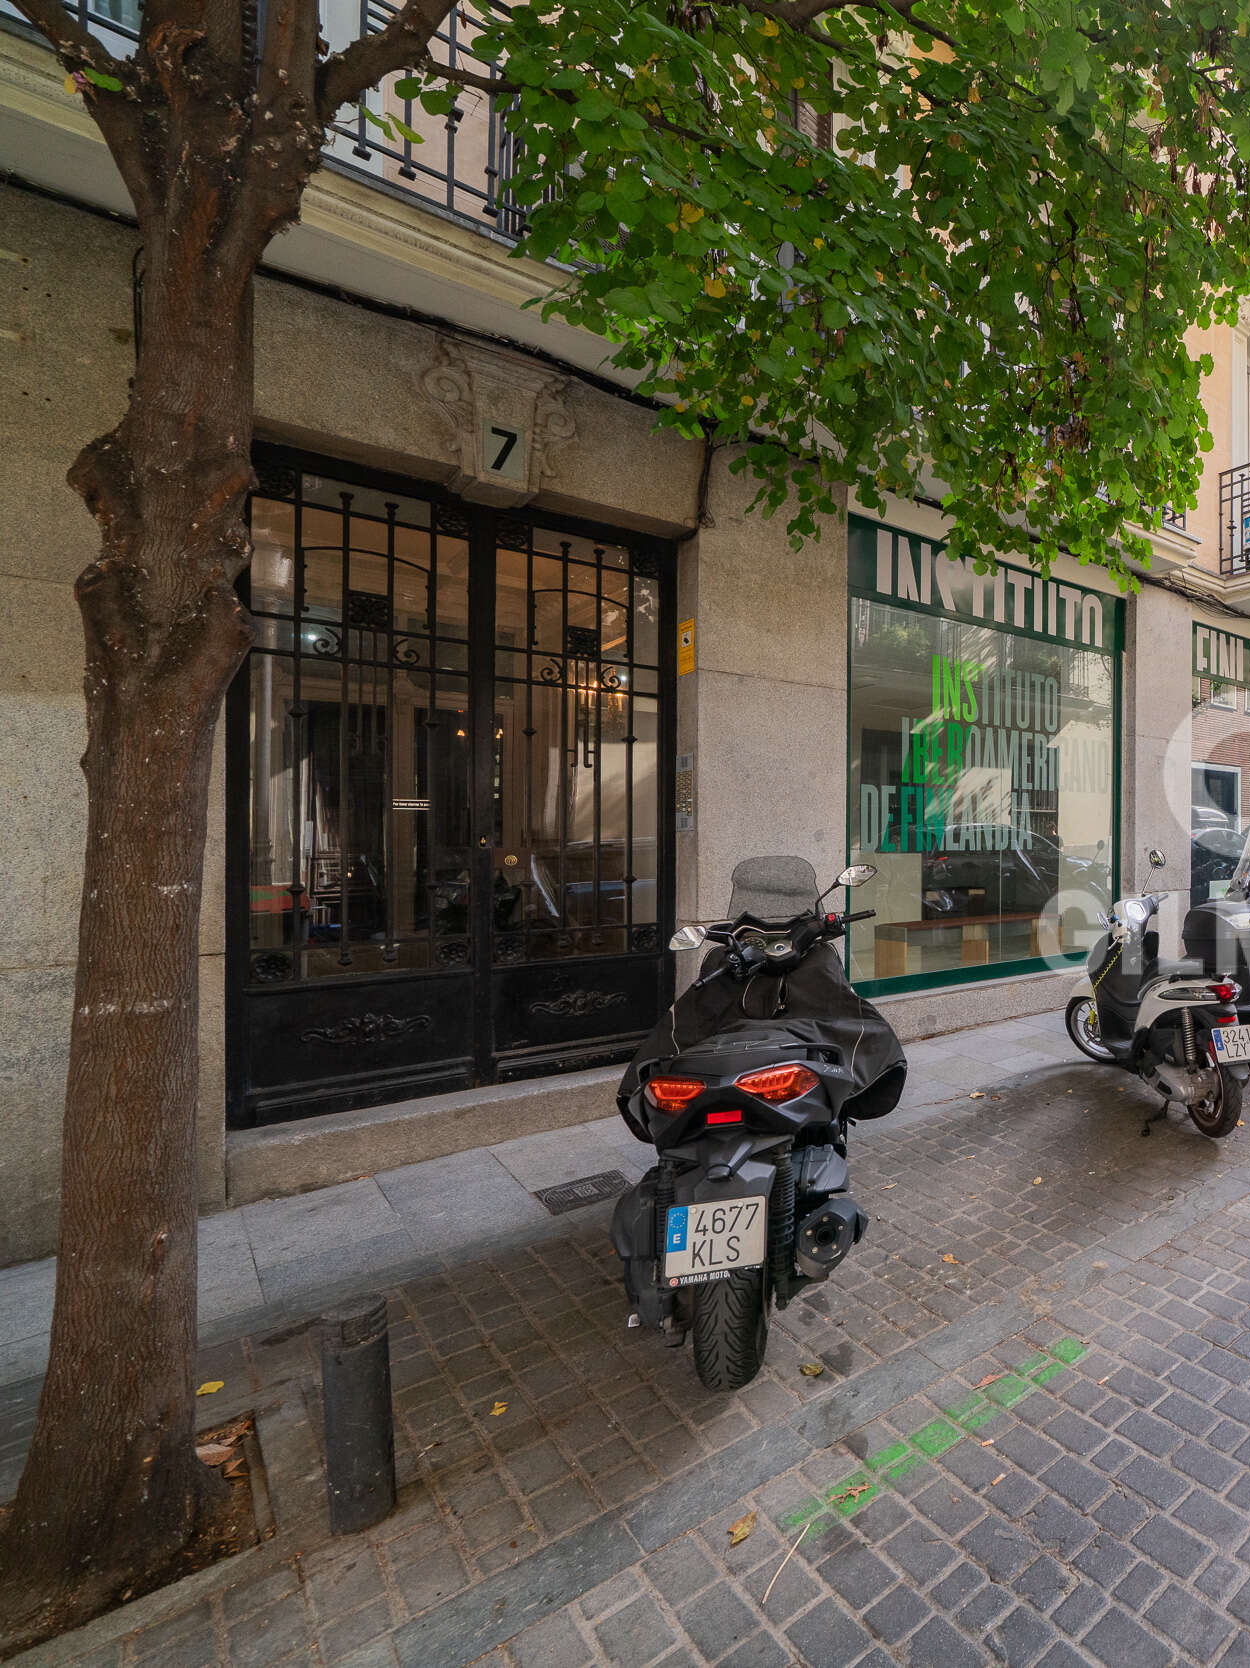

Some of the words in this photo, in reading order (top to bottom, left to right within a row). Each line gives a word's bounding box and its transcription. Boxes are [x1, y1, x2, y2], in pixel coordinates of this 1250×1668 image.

[491, 426, 517, 471] 7
[931, 654, 1058, 733] INSTITUTO
[1222, 1028, 1250, 1044] 3241
[1223, 1042, 1247, 1059] LZY
[694, 1202, 760, 1237] 4677
[673, 1233, 682, 1244] E
[691, 1235, 741, 1269] KLS
[679, 1273, 708, 1286] YAMAHA
